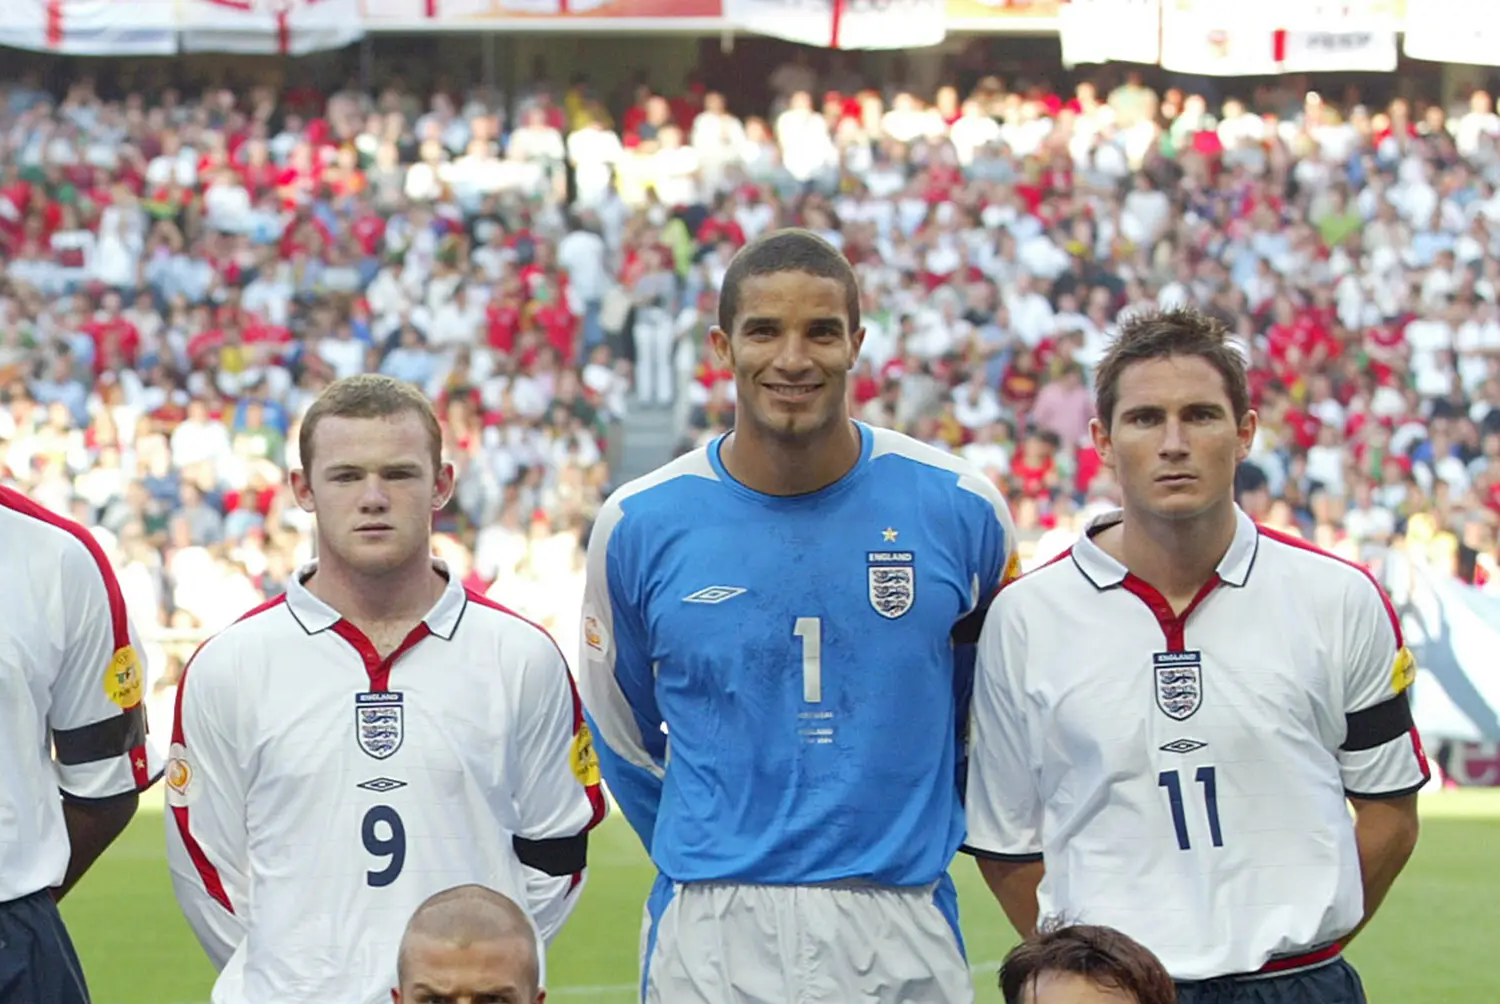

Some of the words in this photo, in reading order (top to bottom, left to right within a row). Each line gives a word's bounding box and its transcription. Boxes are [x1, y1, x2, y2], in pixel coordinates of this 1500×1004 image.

[869, 553, 912, 562] ENGLAND
[793, 617, 822, 703] 1
[1158, 653, 1197, 662] ENGLAND
[360, 693, 399, 702] ENGLAND
[1159, 766, 1224, 850] 11
[361, 805, 407, 888] 9
